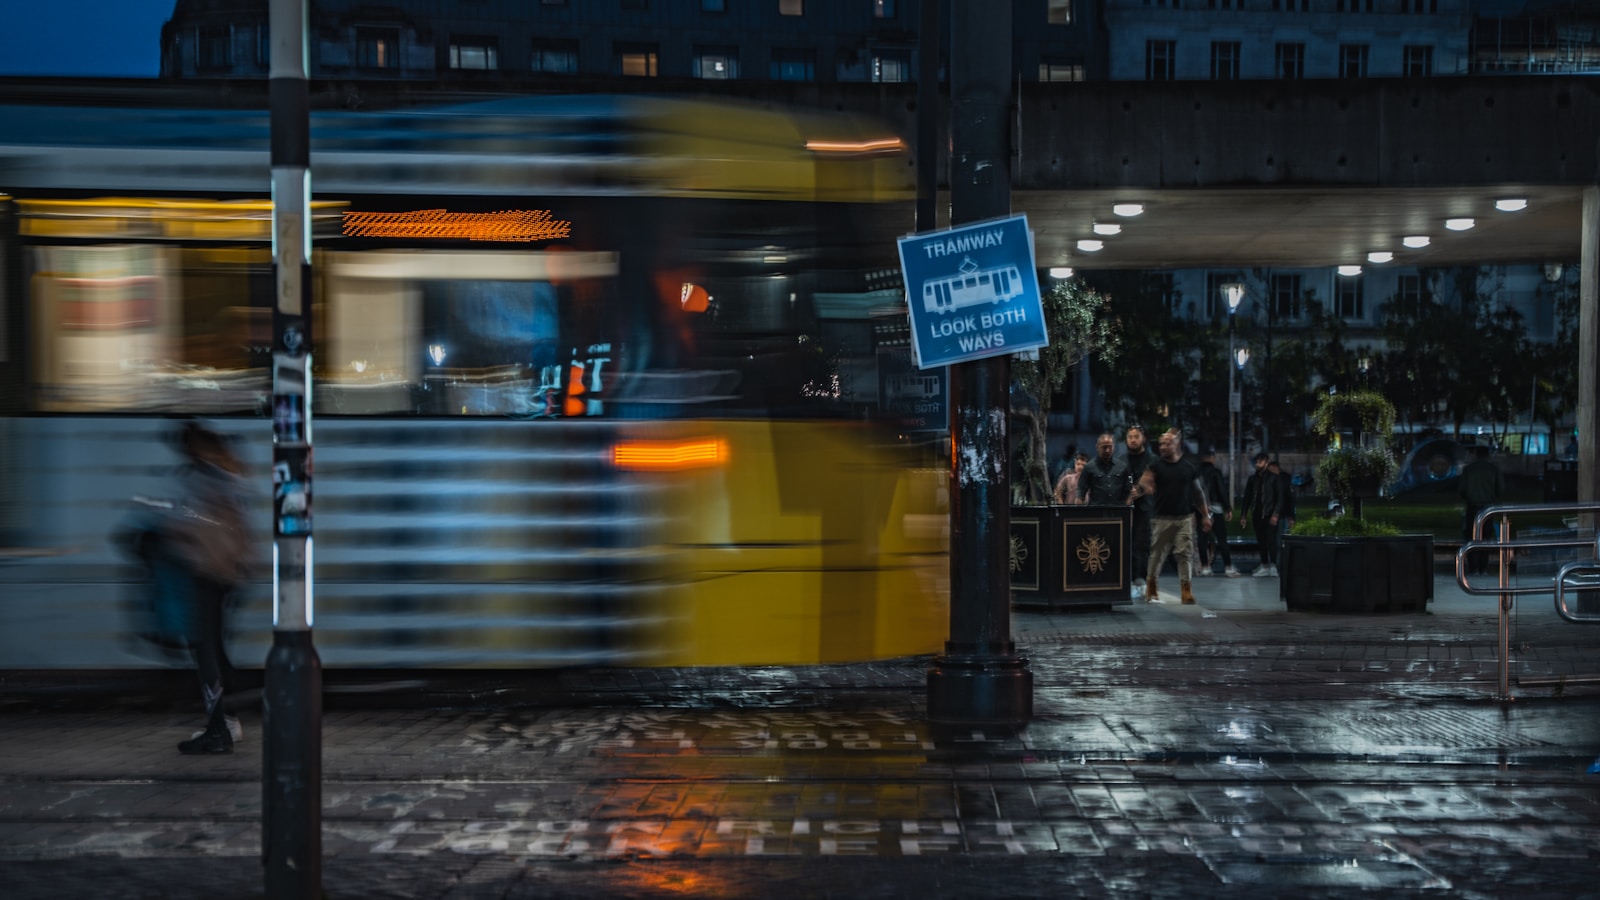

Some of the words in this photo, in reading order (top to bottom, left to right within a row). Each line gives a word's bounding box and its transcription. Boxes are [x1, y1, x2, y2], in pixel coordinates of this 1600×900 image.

[923, 229, 1004, 258] TRAMWAY
[930, 316, 977, 338] LOOK
[980, 308, 1026, 329] BOTH
[958, 331, 1005, 353] WAYS
[914, 402, 939, 413] BOTH
[388, 820, 665, 835] LOOK
[716, 820, 1031, 835] RIGHT
[370, 839, 671, 856] LOOK
[744, 837, 1028, 855] LEFT
